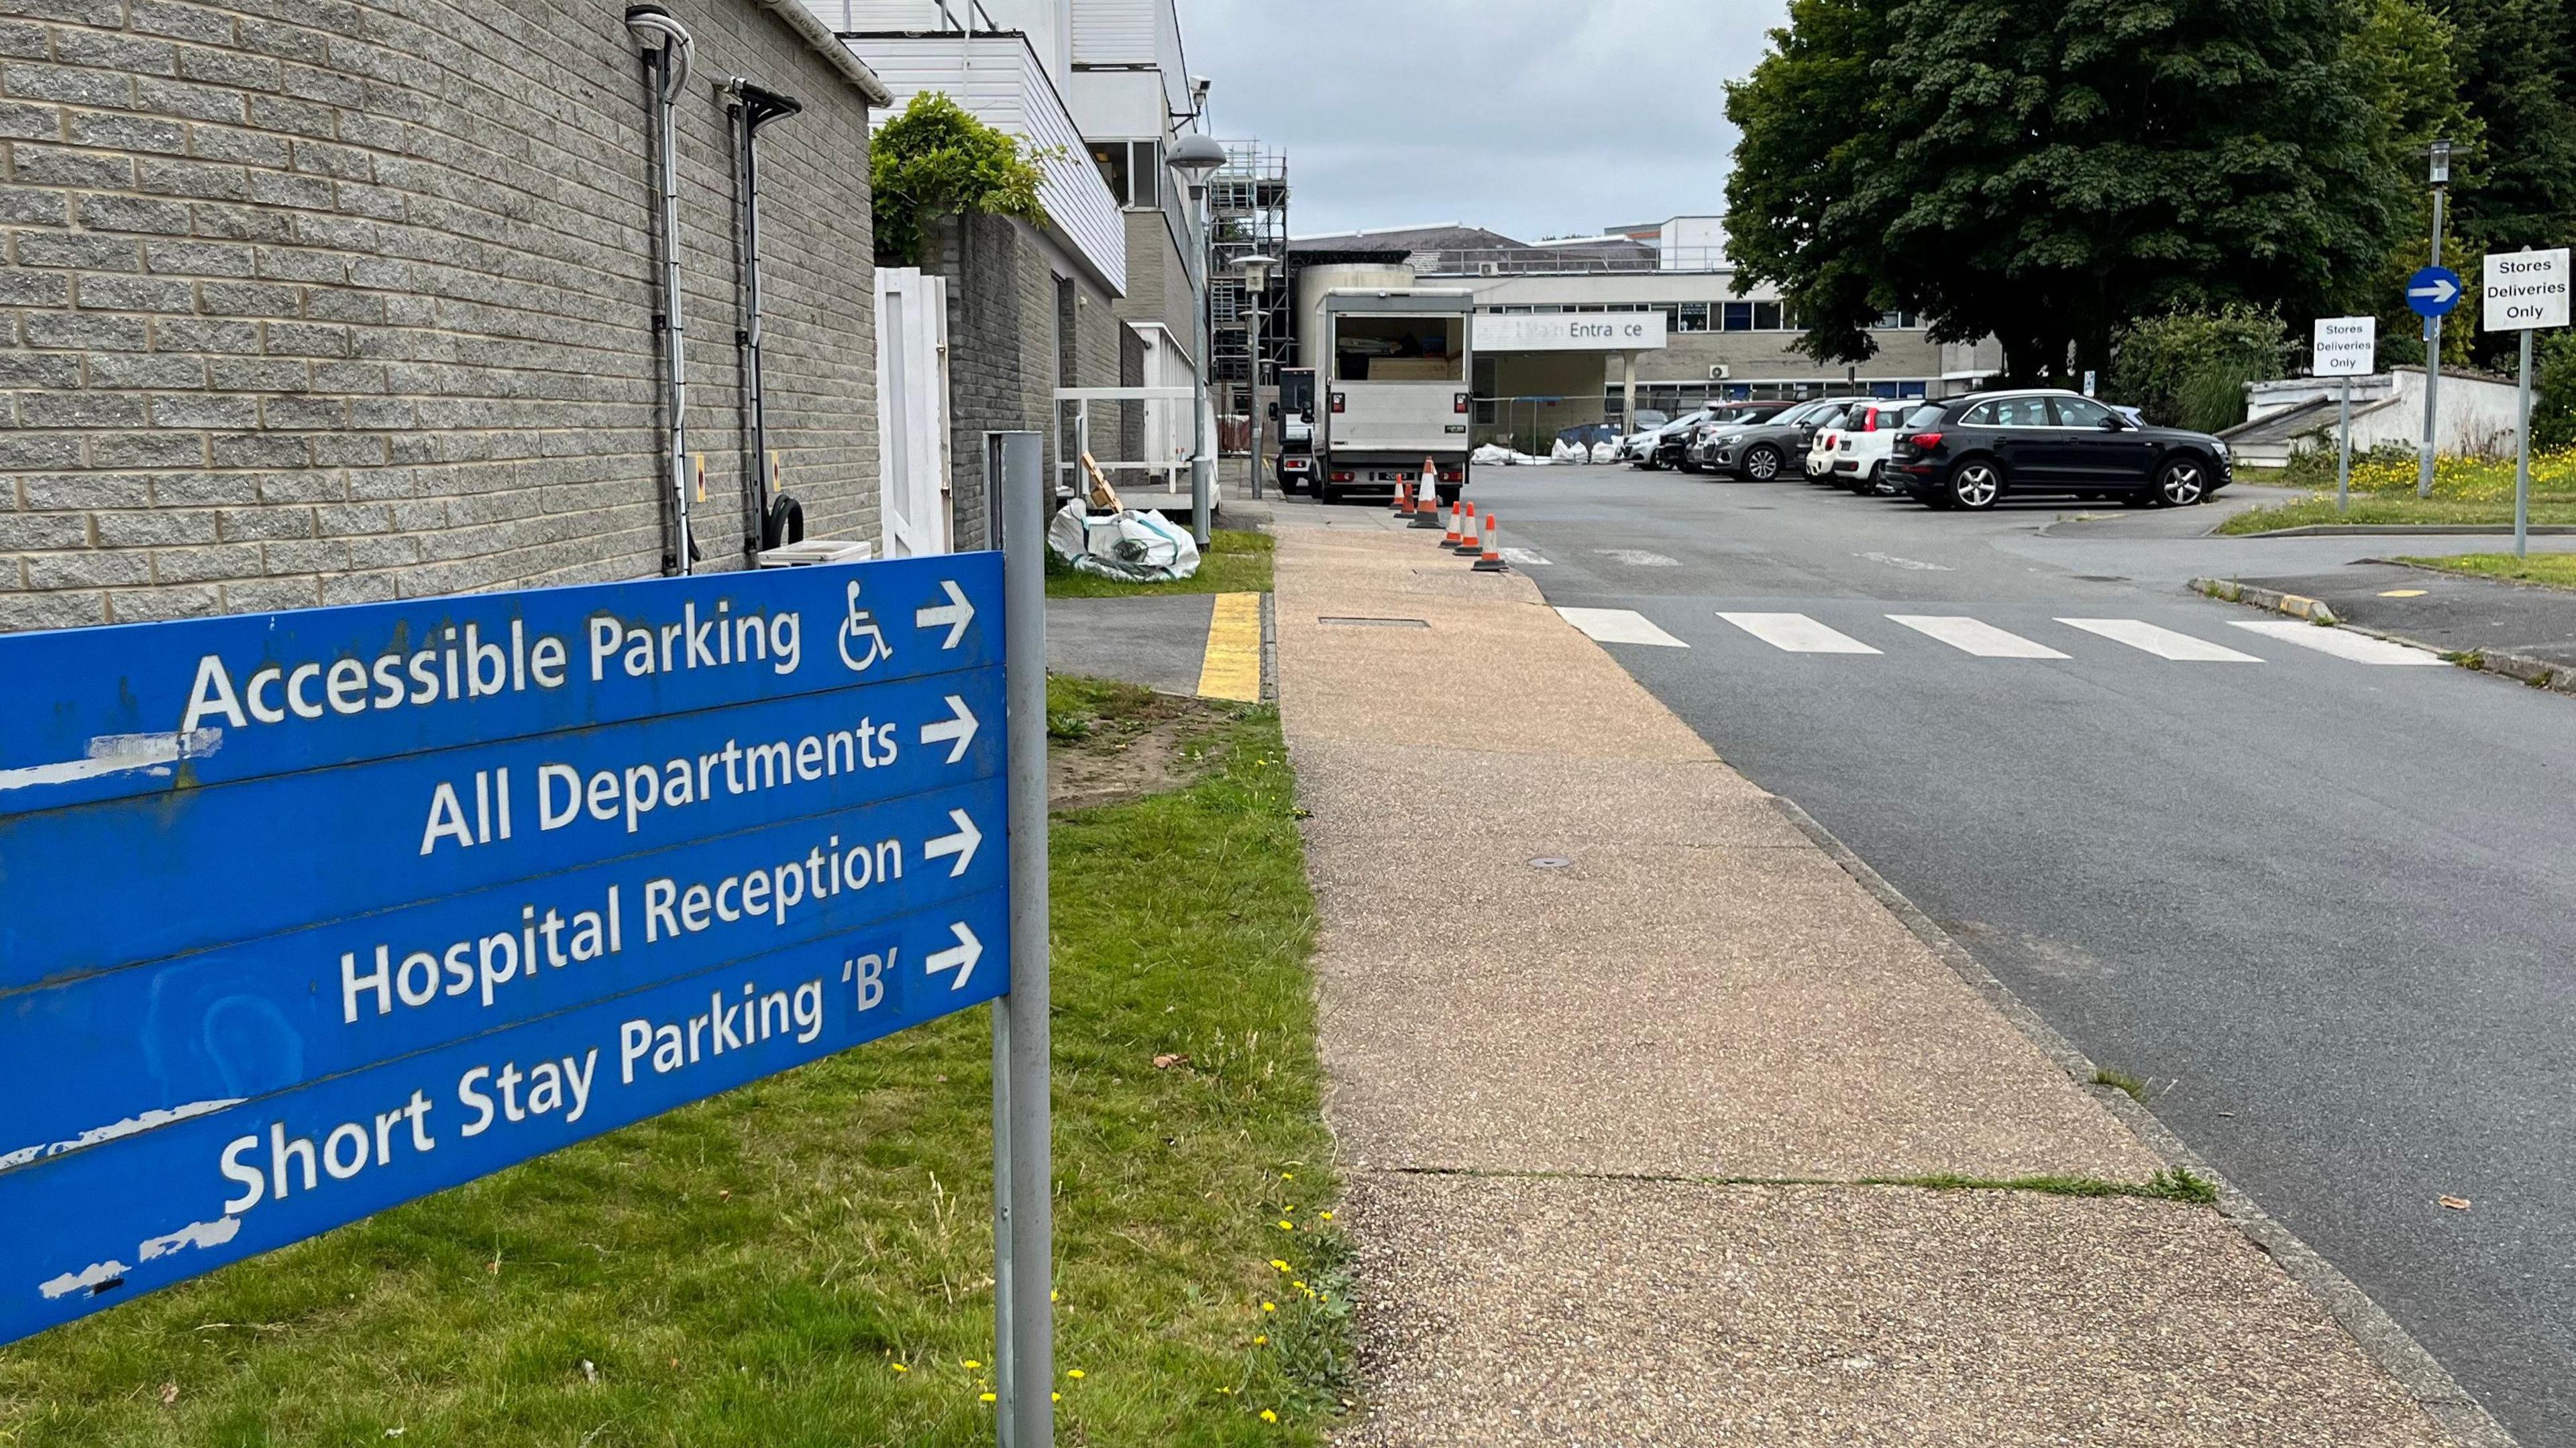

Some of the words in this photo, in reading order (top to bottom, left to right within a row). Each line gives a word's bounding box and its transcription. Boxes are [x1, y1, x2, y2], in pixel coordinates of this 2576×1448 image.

[2500, 261, 2552, 274] Stores
[2487, 282, 2566, 298] Deliveries
[2506, 305, 2544, 320] Only
[2326, 325, 2363, 335] Stores
[2316, 341, 2371, 351] Deliveries
[2330, 358, 2356, 370] Only
[181, 620, 567, 734] Accessible
[590, 599, 801, 681] Parking
[420, 771, 511, 855] All
[539, 716, 899, 833] Departments
[341, 885, 622, 1023] Hospital
[645, 835, 903, 944] Reception
[221, 1089, 435, 1214] Short
[458, 1048, 598, 1137] Stay
[621, 976, 824, 1084] Parking
